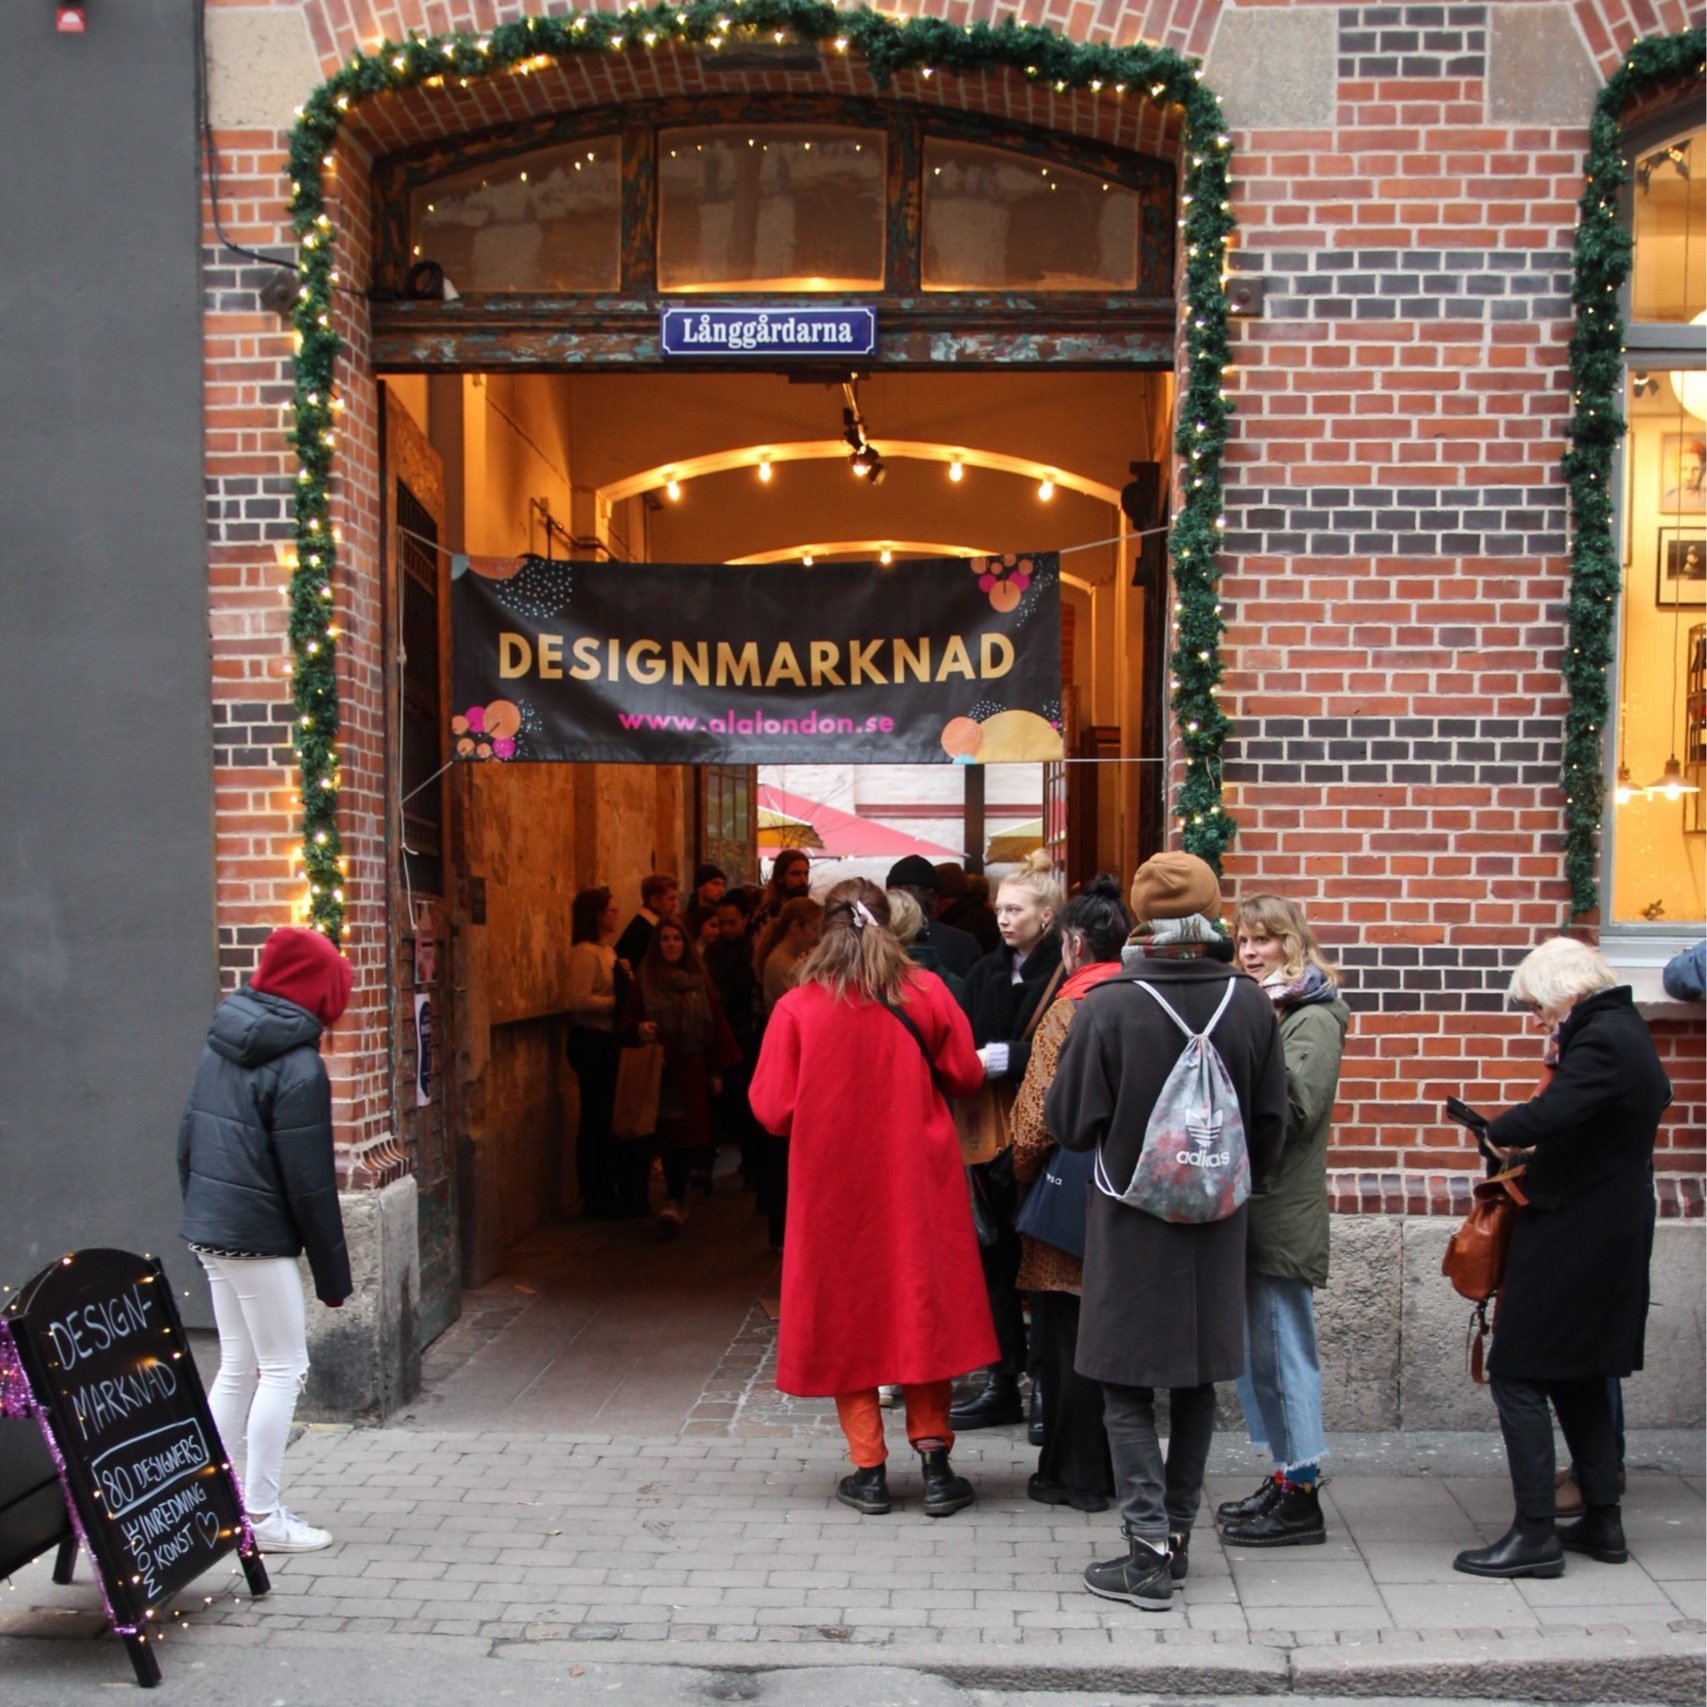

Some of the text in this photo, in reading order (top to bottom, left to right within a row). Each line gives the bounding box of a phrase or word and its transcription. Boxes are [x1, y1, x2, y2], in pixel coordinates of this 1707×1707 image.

[682, 314, 853, 349] Långgårdarna
[498, 632, 1016, 688] DESIGNMARKNAD
[618, 709, 896, 736] www.alalondon.se
[50, 1283, 153, 1371] DESIGN-
[71, 1361, 177, 1441] MARKNAD
[101, 1435, 204, 1509] 80 DESIGNERS
[138, 1482, 208, 1545] INREDNING
[120, 1518, 163, 1599] MODE
[153, 1522, 195, 1571] KONST
